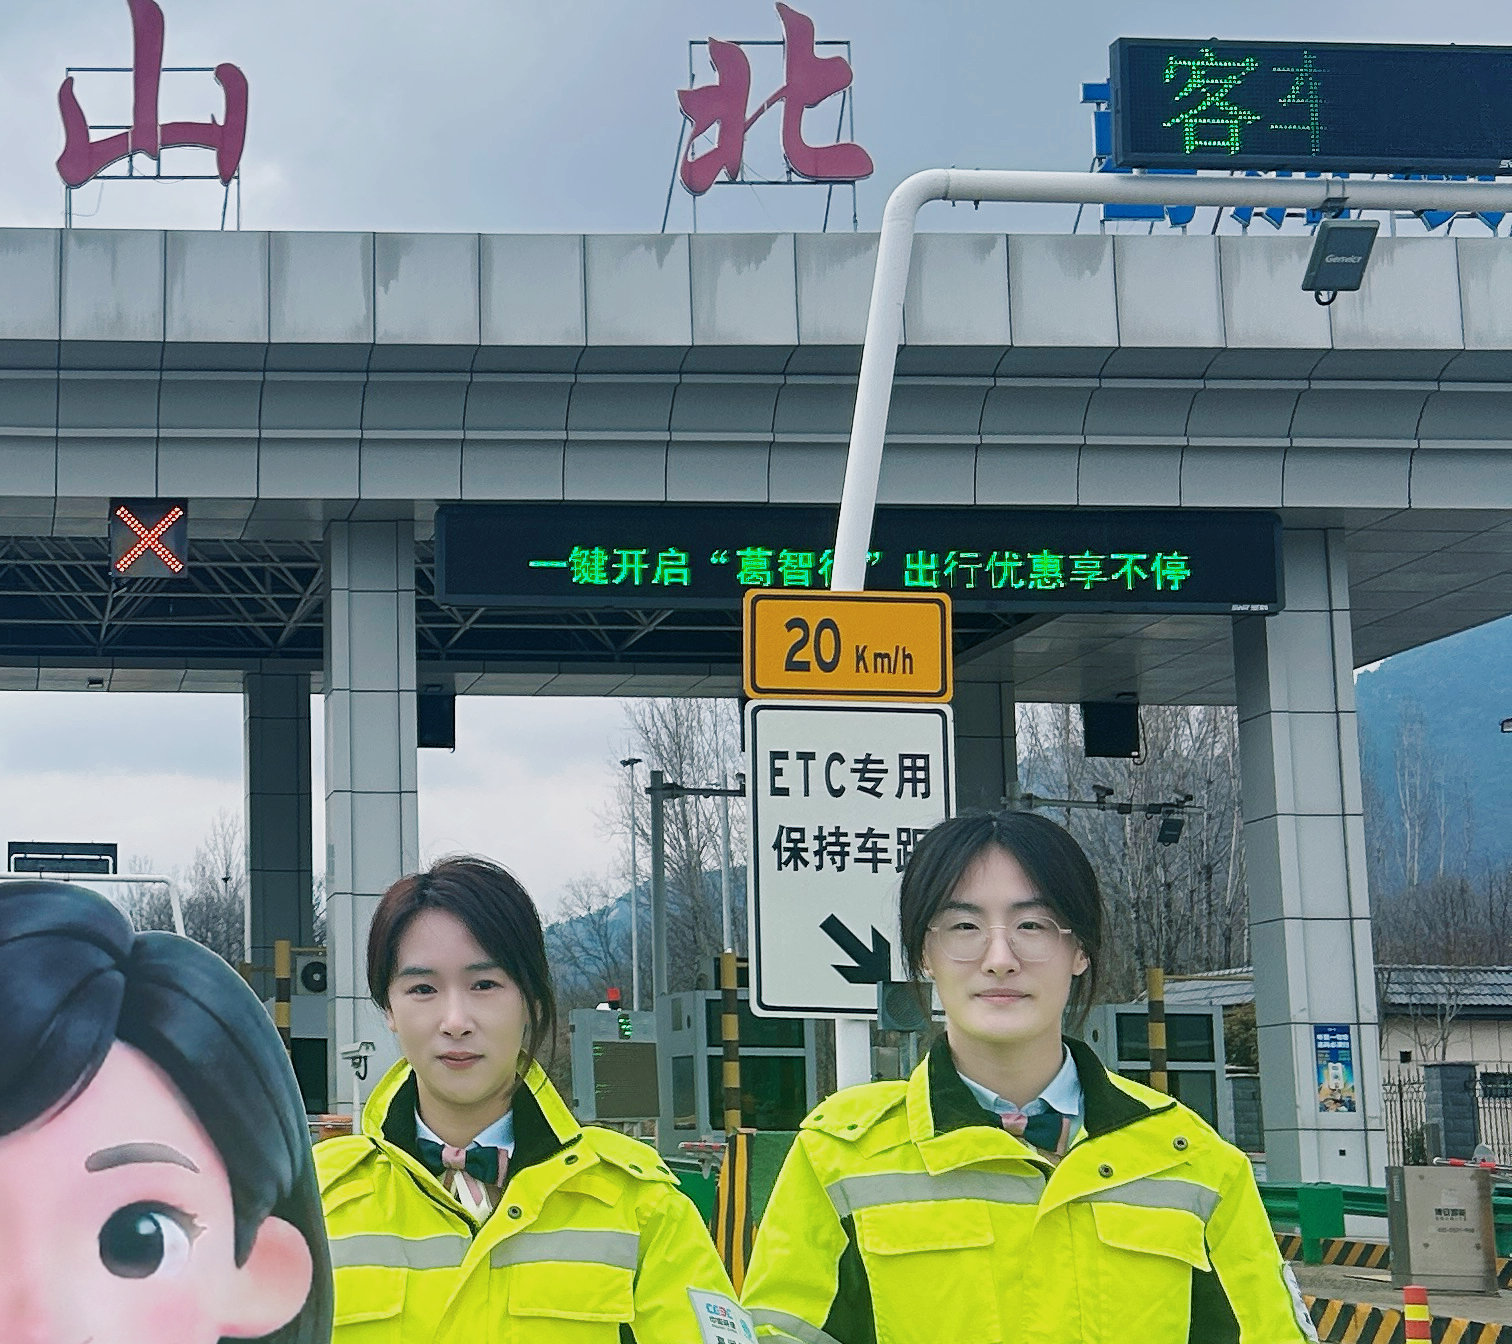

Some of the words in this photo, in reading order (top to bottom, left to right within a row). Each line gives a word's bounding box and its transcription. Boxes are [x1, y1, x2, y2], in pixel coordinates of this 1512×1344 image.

[784, 617, 842, 673] 20
[854, 645, 915, 675] Km/h
[769, 751, 931, 799] ETC专用
